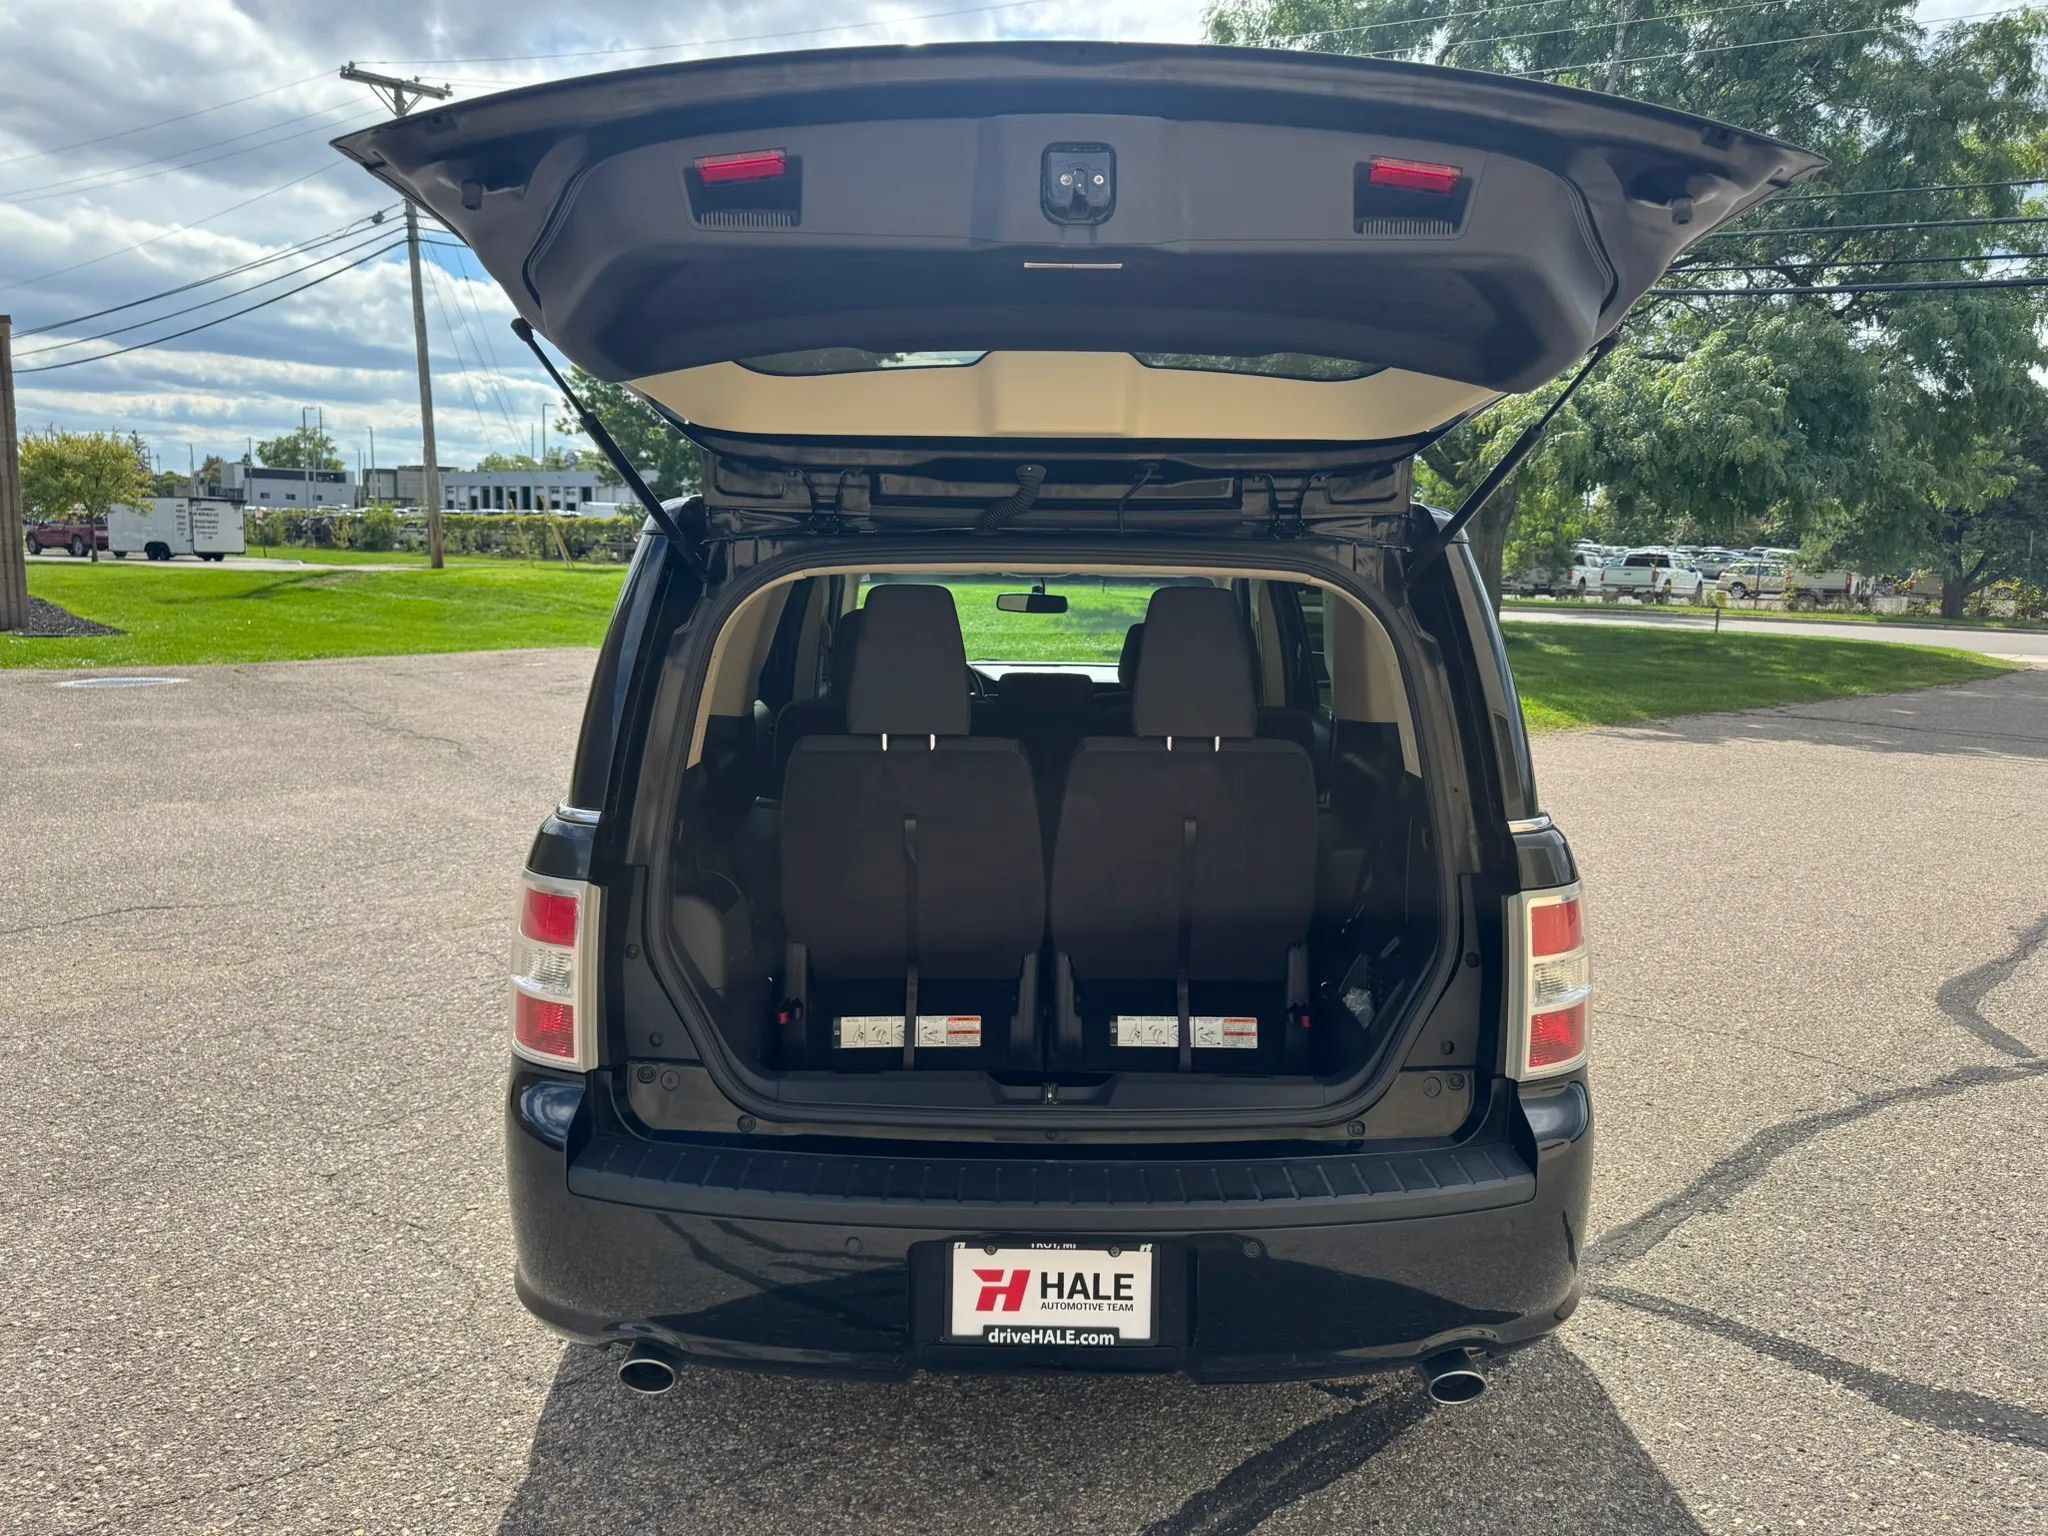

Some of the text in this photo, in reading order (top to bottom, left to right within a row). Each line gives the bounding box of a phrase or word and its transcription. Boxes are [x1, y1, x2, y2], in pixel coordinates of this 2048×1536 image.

[1040, 1272, 1134, 1301] HALE
[1041, 1302, 1134, 1312] AUTOMOTIVE TEAM
[988, 1328, 1115, 1345] driveHALE.com
